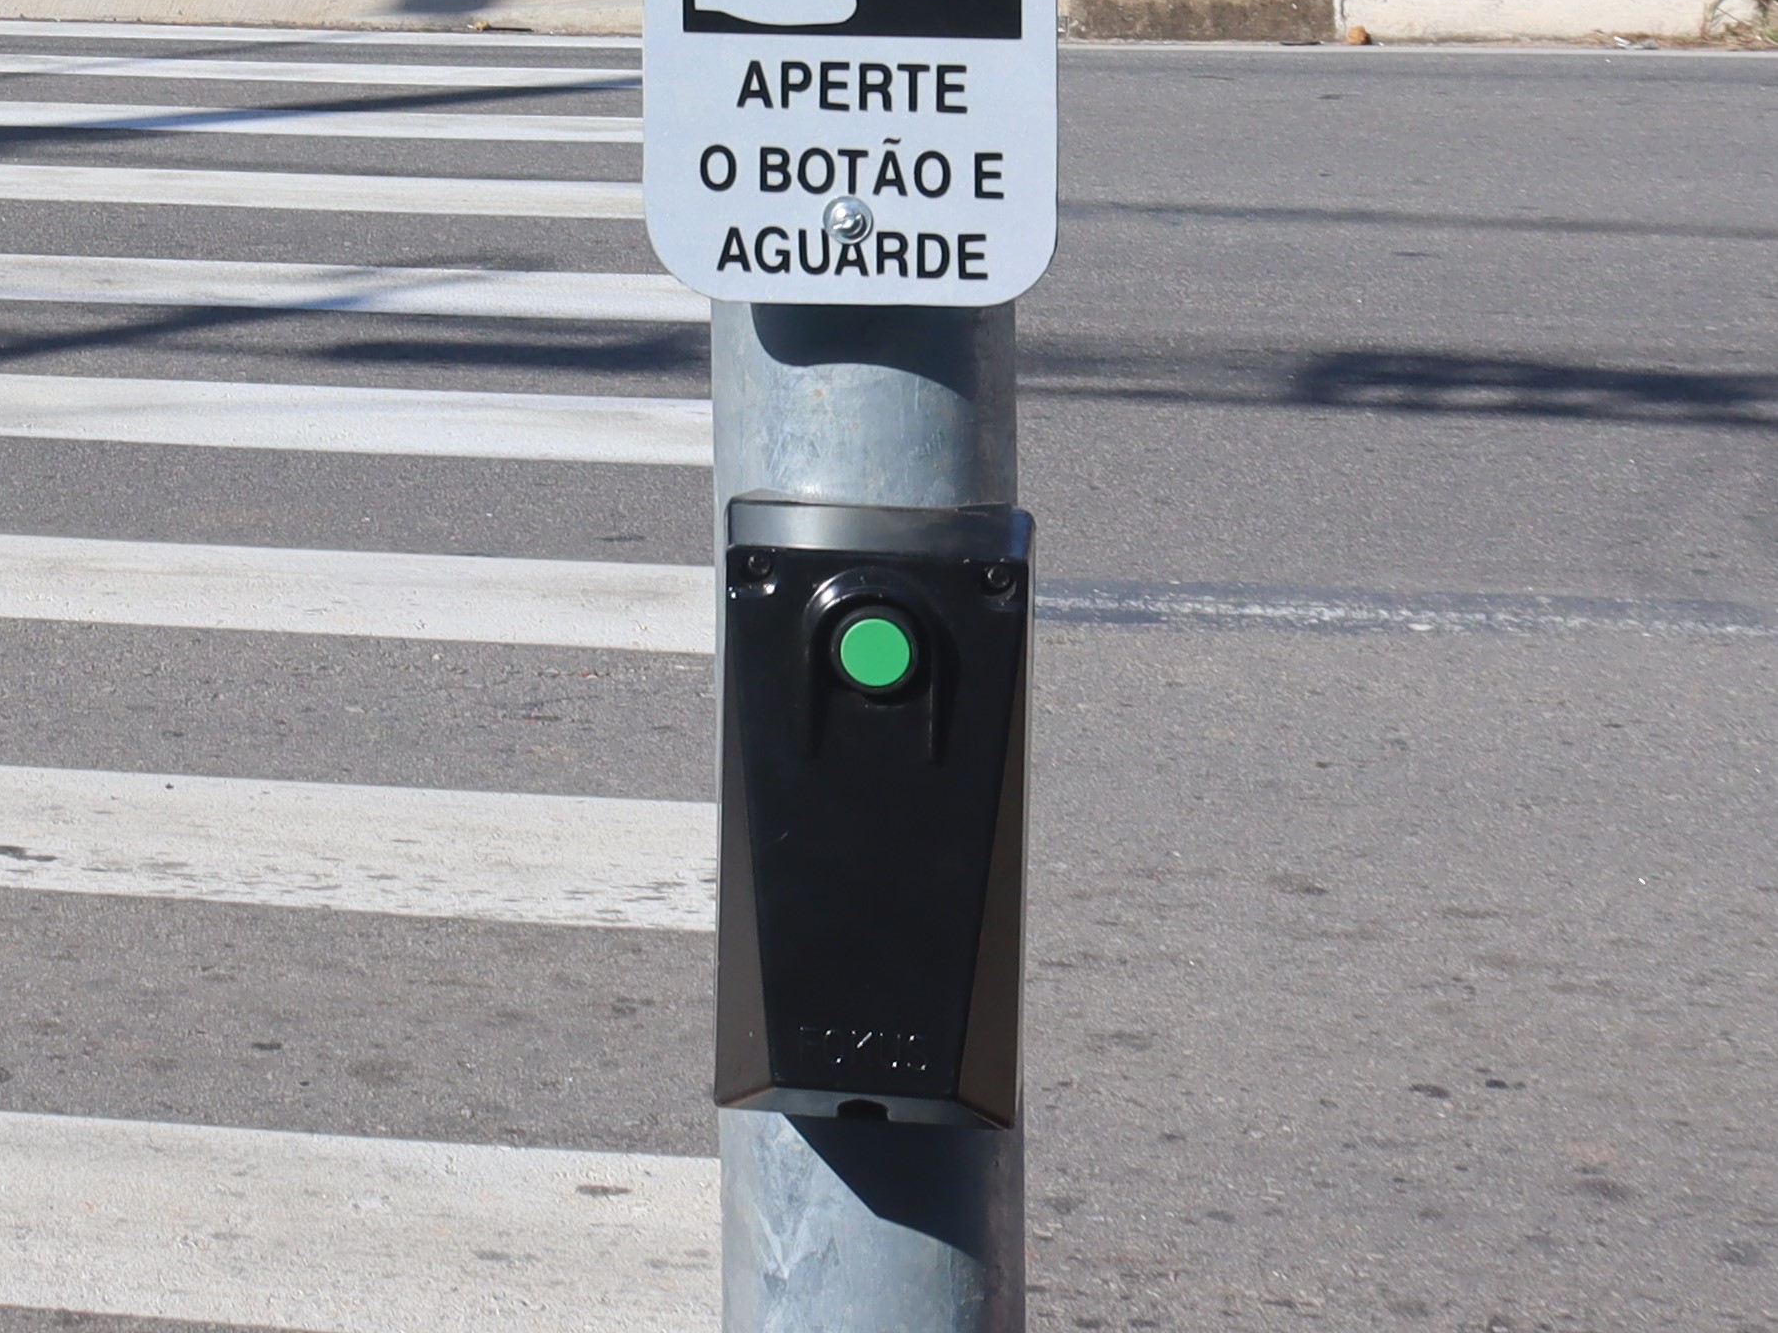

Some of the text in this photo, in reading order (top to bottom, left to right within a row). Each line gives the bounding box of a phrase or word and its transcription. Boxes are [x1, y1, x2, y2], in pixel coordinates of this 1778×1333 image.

[737, 60, 969, 114] APERTE
[699, 138, 1005, 200] O BOTÃO E
[716, 226, 990, 282] AGUARDE
[797, 1025, 930, 1073] FOKUS
